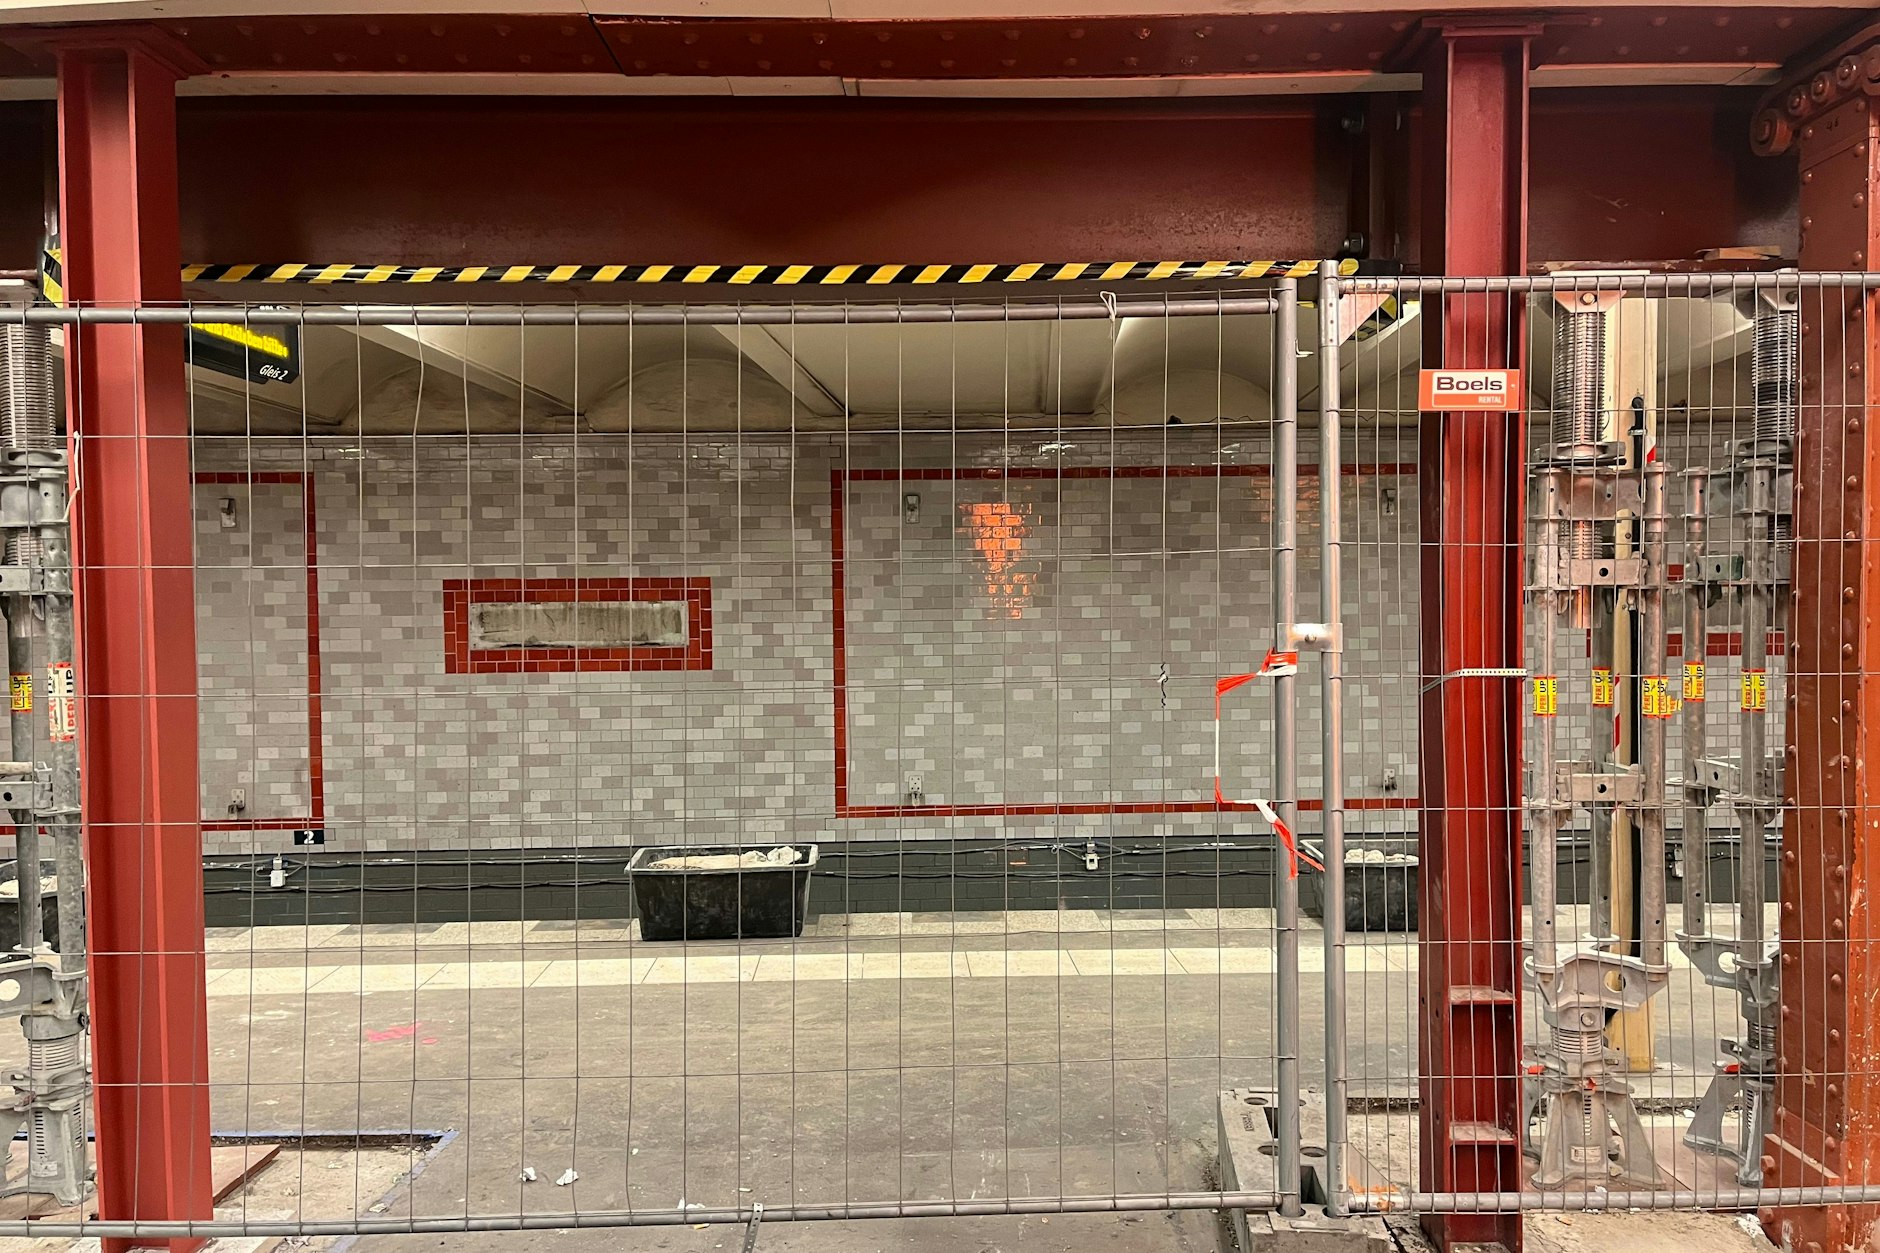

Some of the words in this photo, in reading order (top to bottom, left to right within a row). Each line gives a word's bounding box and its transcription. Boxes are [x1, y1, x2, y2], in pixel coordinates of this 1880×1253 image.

[260, 364, 281, 378] Gleis
[278, 370, 289, 381] 2
[1436, 376, 1503, 391] Boels
[1478, 395, 1503, 404] RENTAL
[13, 676, 21, 689] UP
[1539, 680, 1547, 693] UP
[1643, 680, 1651, 693] UP
[303, 830, 315, 844] 2
